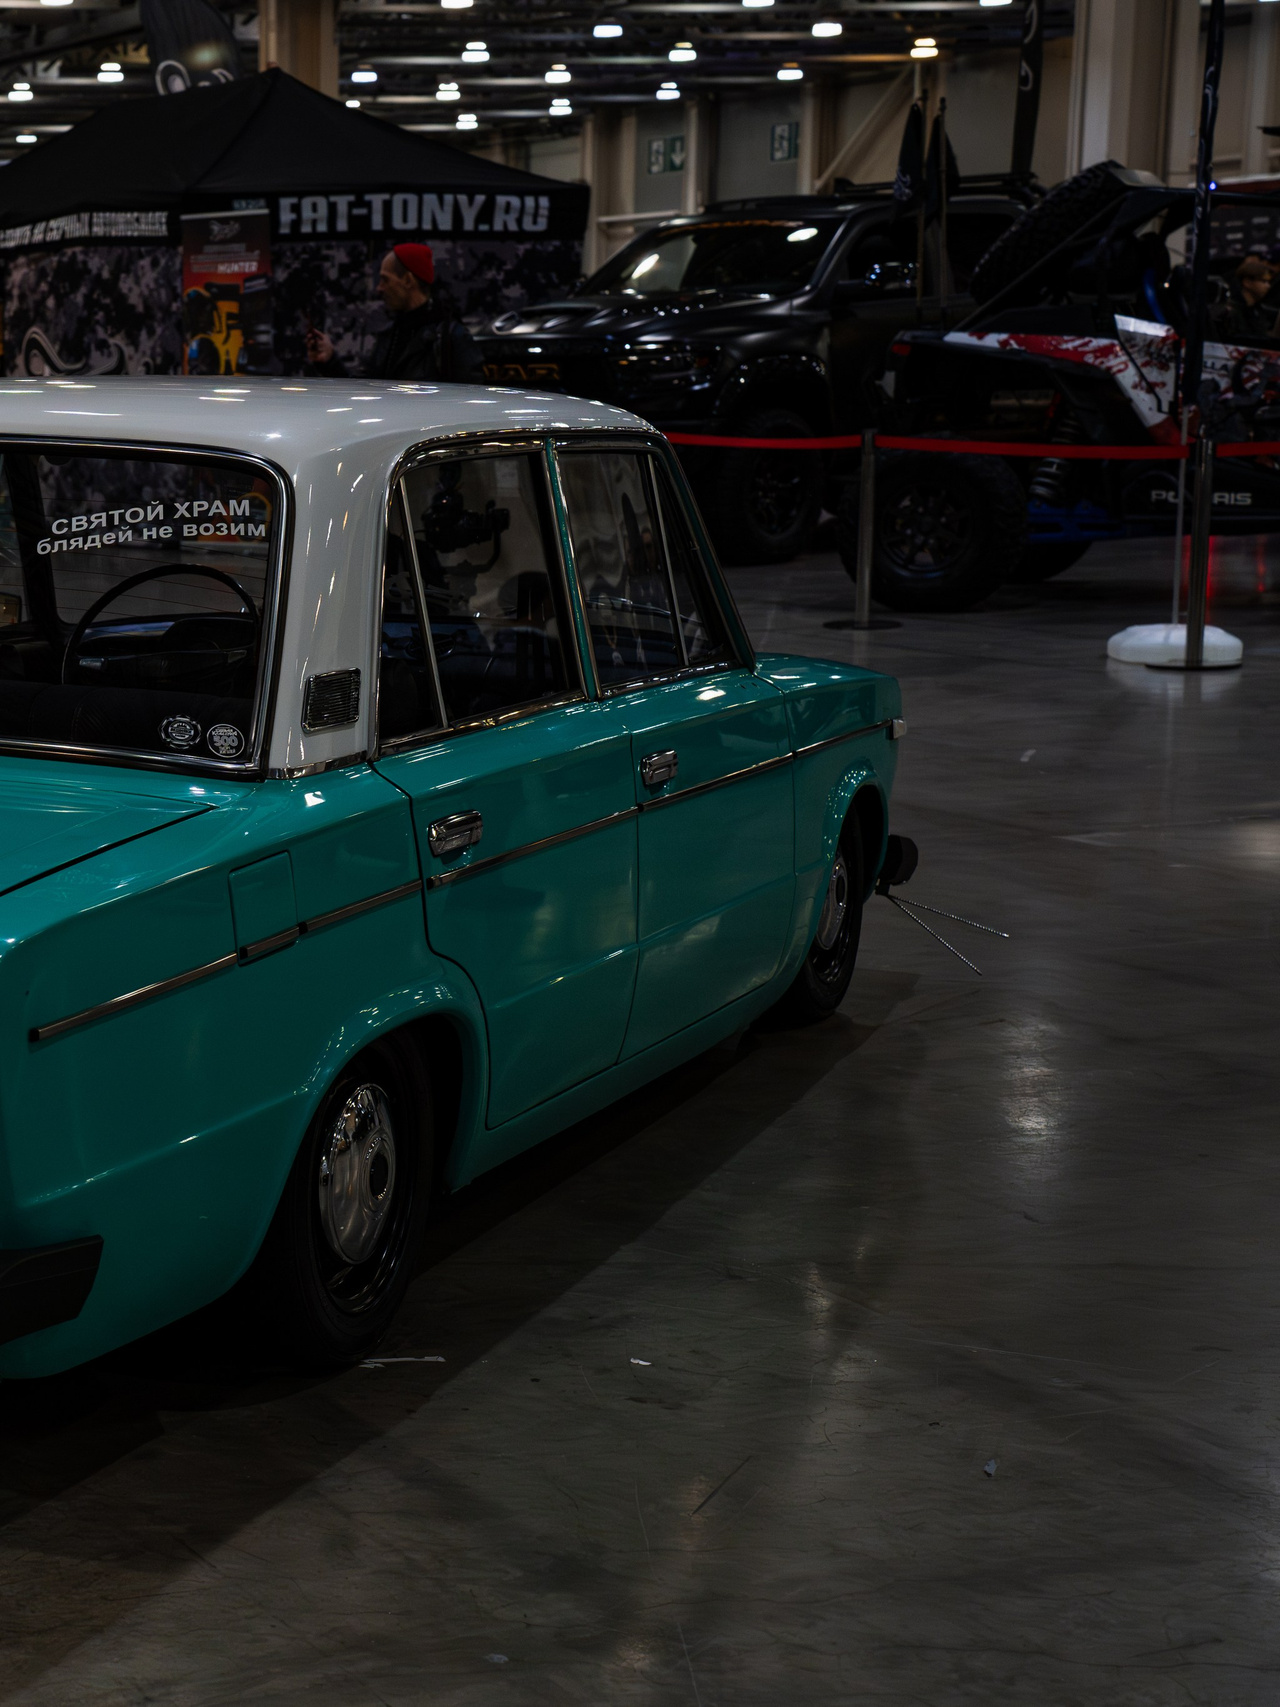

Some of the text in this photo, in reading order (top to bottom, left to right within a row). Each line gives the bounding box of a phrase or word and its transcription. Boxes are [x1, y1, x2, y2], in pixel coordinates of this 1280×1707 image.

[278, 193, 551, 235] FAT-TONY.RU
[51, 499, 250, 535] СВЯТОЙ ХРАМ
[36, 522, 267, 556] блядей не возим
